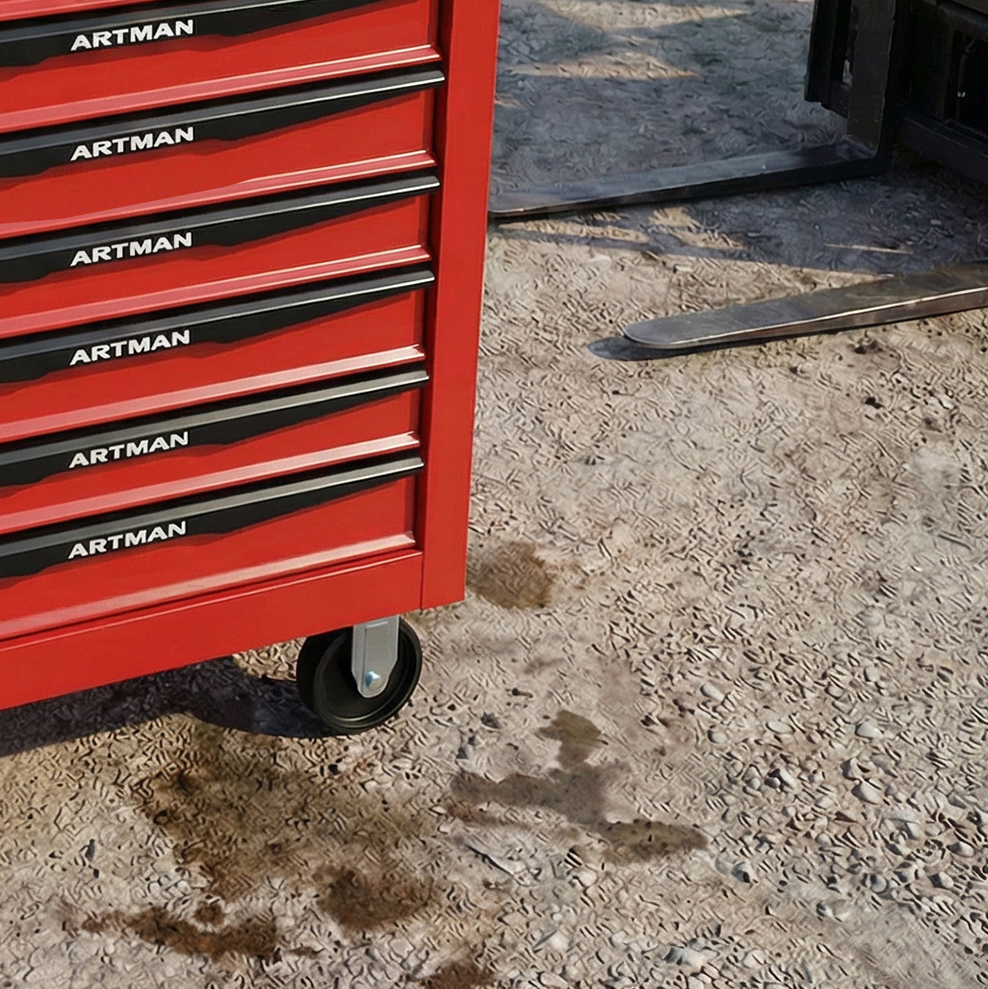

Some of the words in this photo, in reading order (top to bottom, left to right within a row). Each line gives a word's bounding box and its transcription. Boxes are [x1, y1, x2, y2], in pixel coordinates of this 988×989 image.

[70, 20, 194, 51] ARTMAN
[70, 127, 194, 161] ARTMAN
[70, 231, 193, 267] ARTMAN
[69, 330, 191, 366] ARTMAN
[68, 432, 189, 468] ARTMAN
[68, 521, 187, 559] ARTMAN
